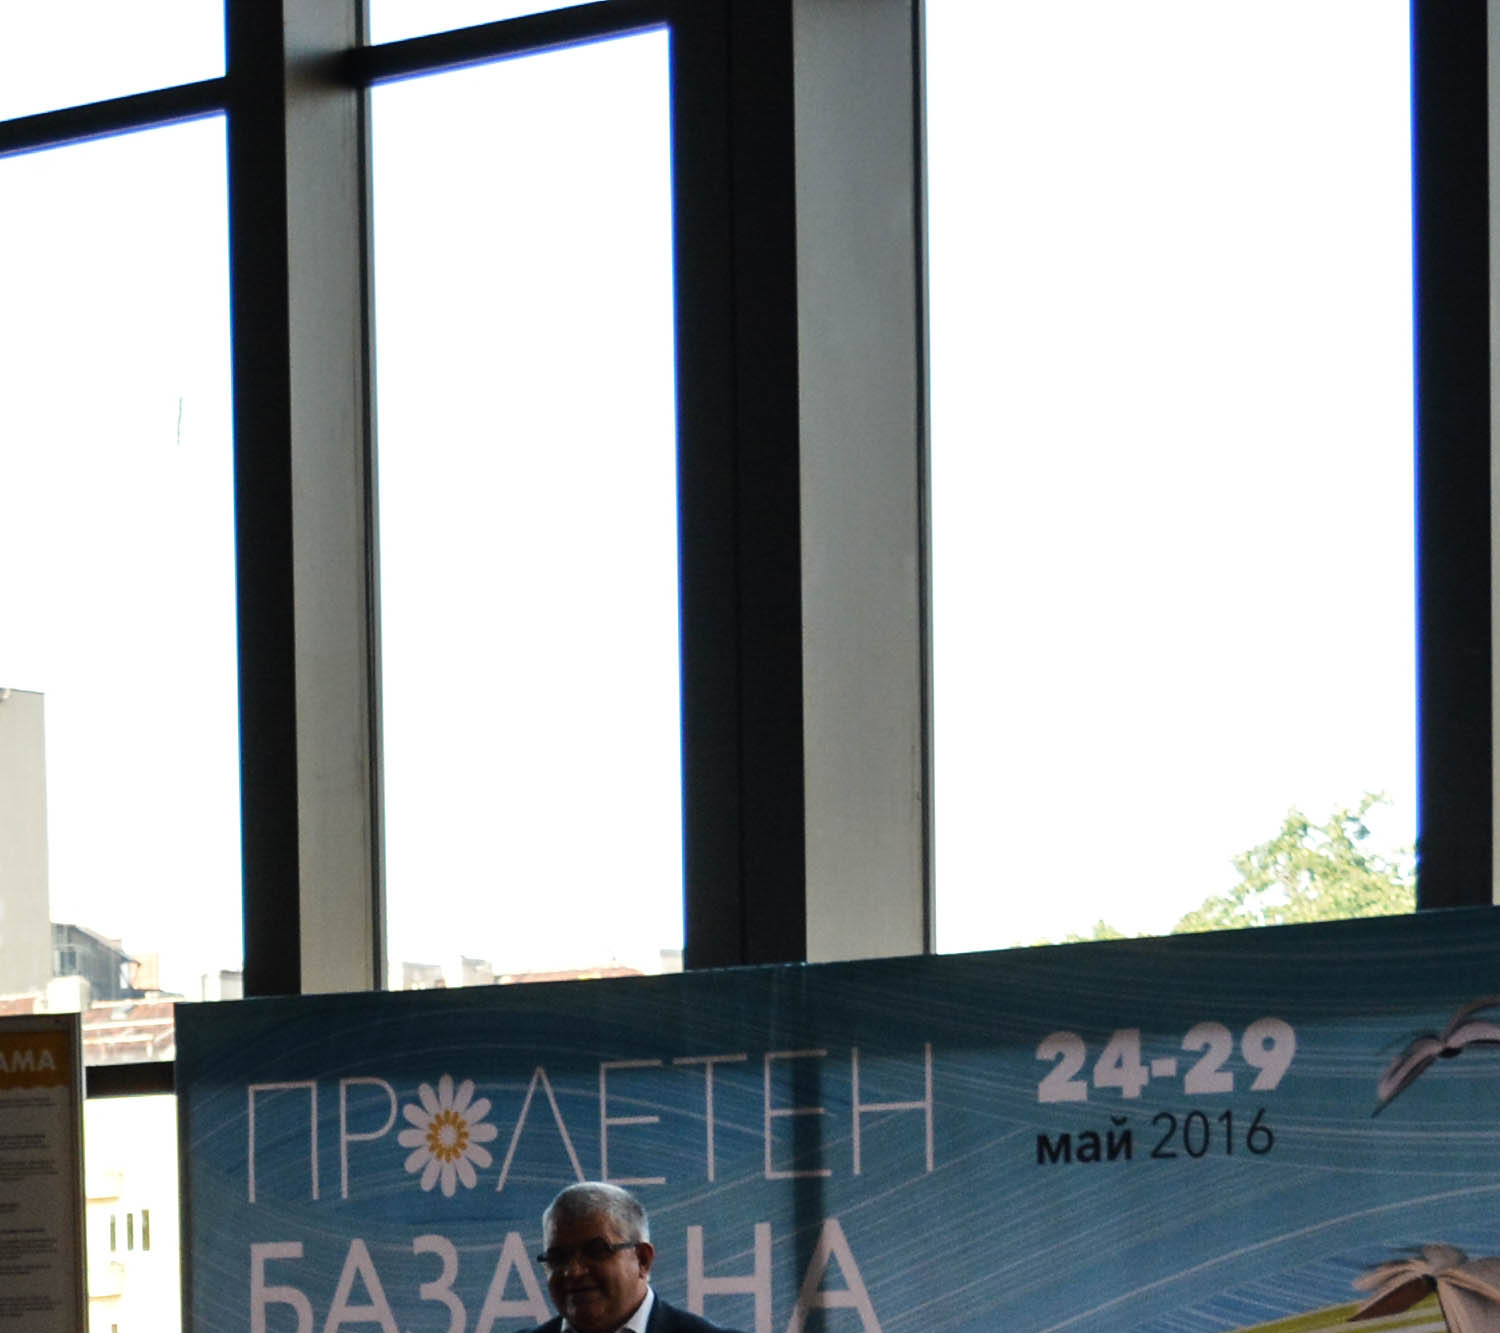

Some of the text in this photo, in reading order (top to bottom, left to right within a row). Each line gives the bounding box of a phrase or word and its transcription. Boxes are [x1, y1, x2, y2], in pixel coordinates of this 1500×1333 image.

[1035, 1016, 1298, 1104] 24-29
[247, 1041, 934, 1203] ПРОЛЕТЕН
[1037, 1107, 1276, 1165] май 2016
